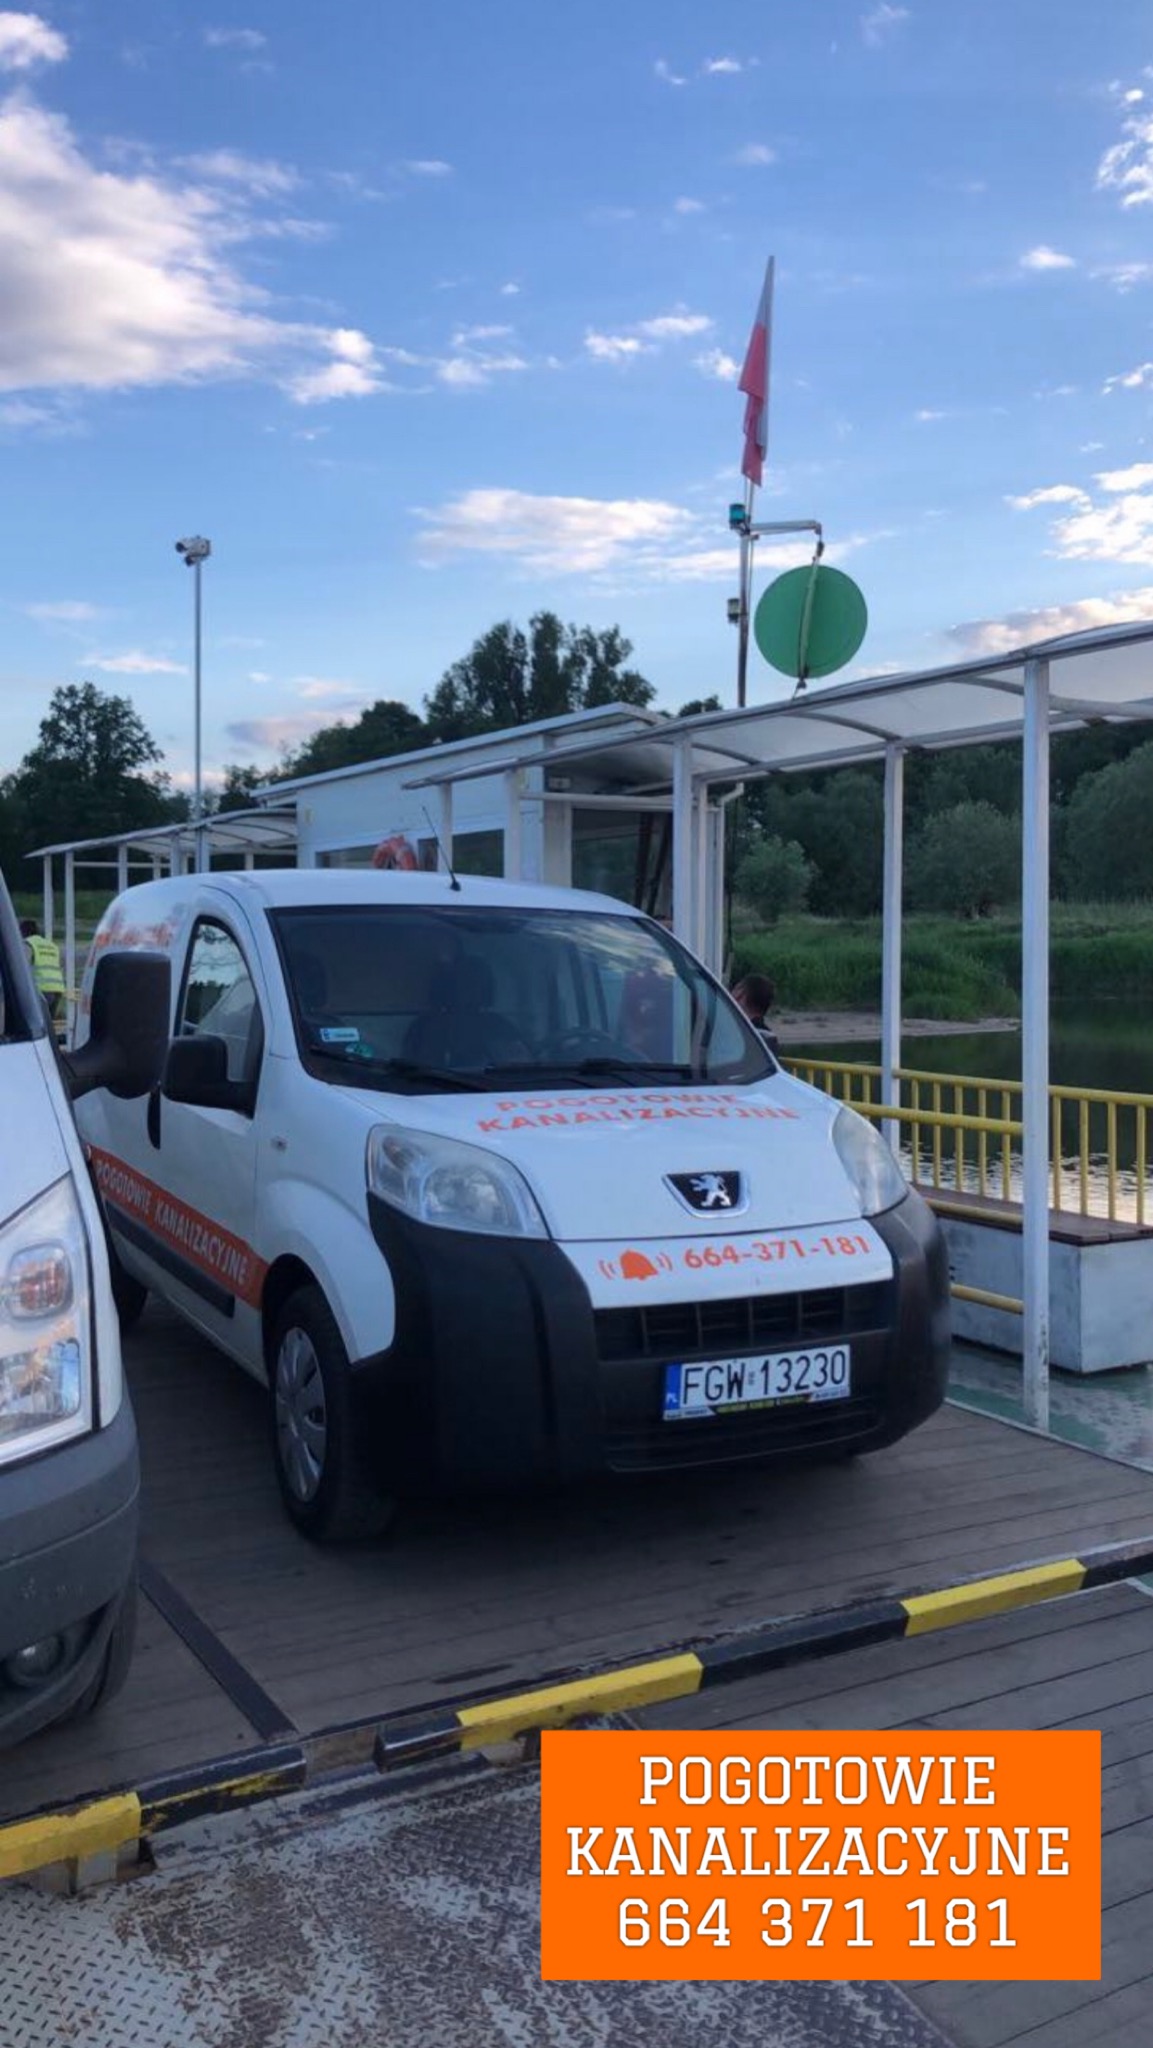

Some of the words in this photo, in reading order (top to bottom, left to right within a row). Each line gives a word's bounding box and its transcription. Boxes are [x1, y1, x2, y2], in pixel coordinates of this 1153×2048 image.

[478, 1107, 800, 1133] KANALIZACYJNE
[497, 1093, 738, 1112] POGOTOWIE
[96, 1159, 151, 1214] POGOTOWIE
[154, 1197, 248, 1285] KANALIZACYJNE
[683, 1234, 871, 1270] 664-371-181
[683, 1362, 746, 1405] FGW
[759, 1350, 847, 1396] 13230
